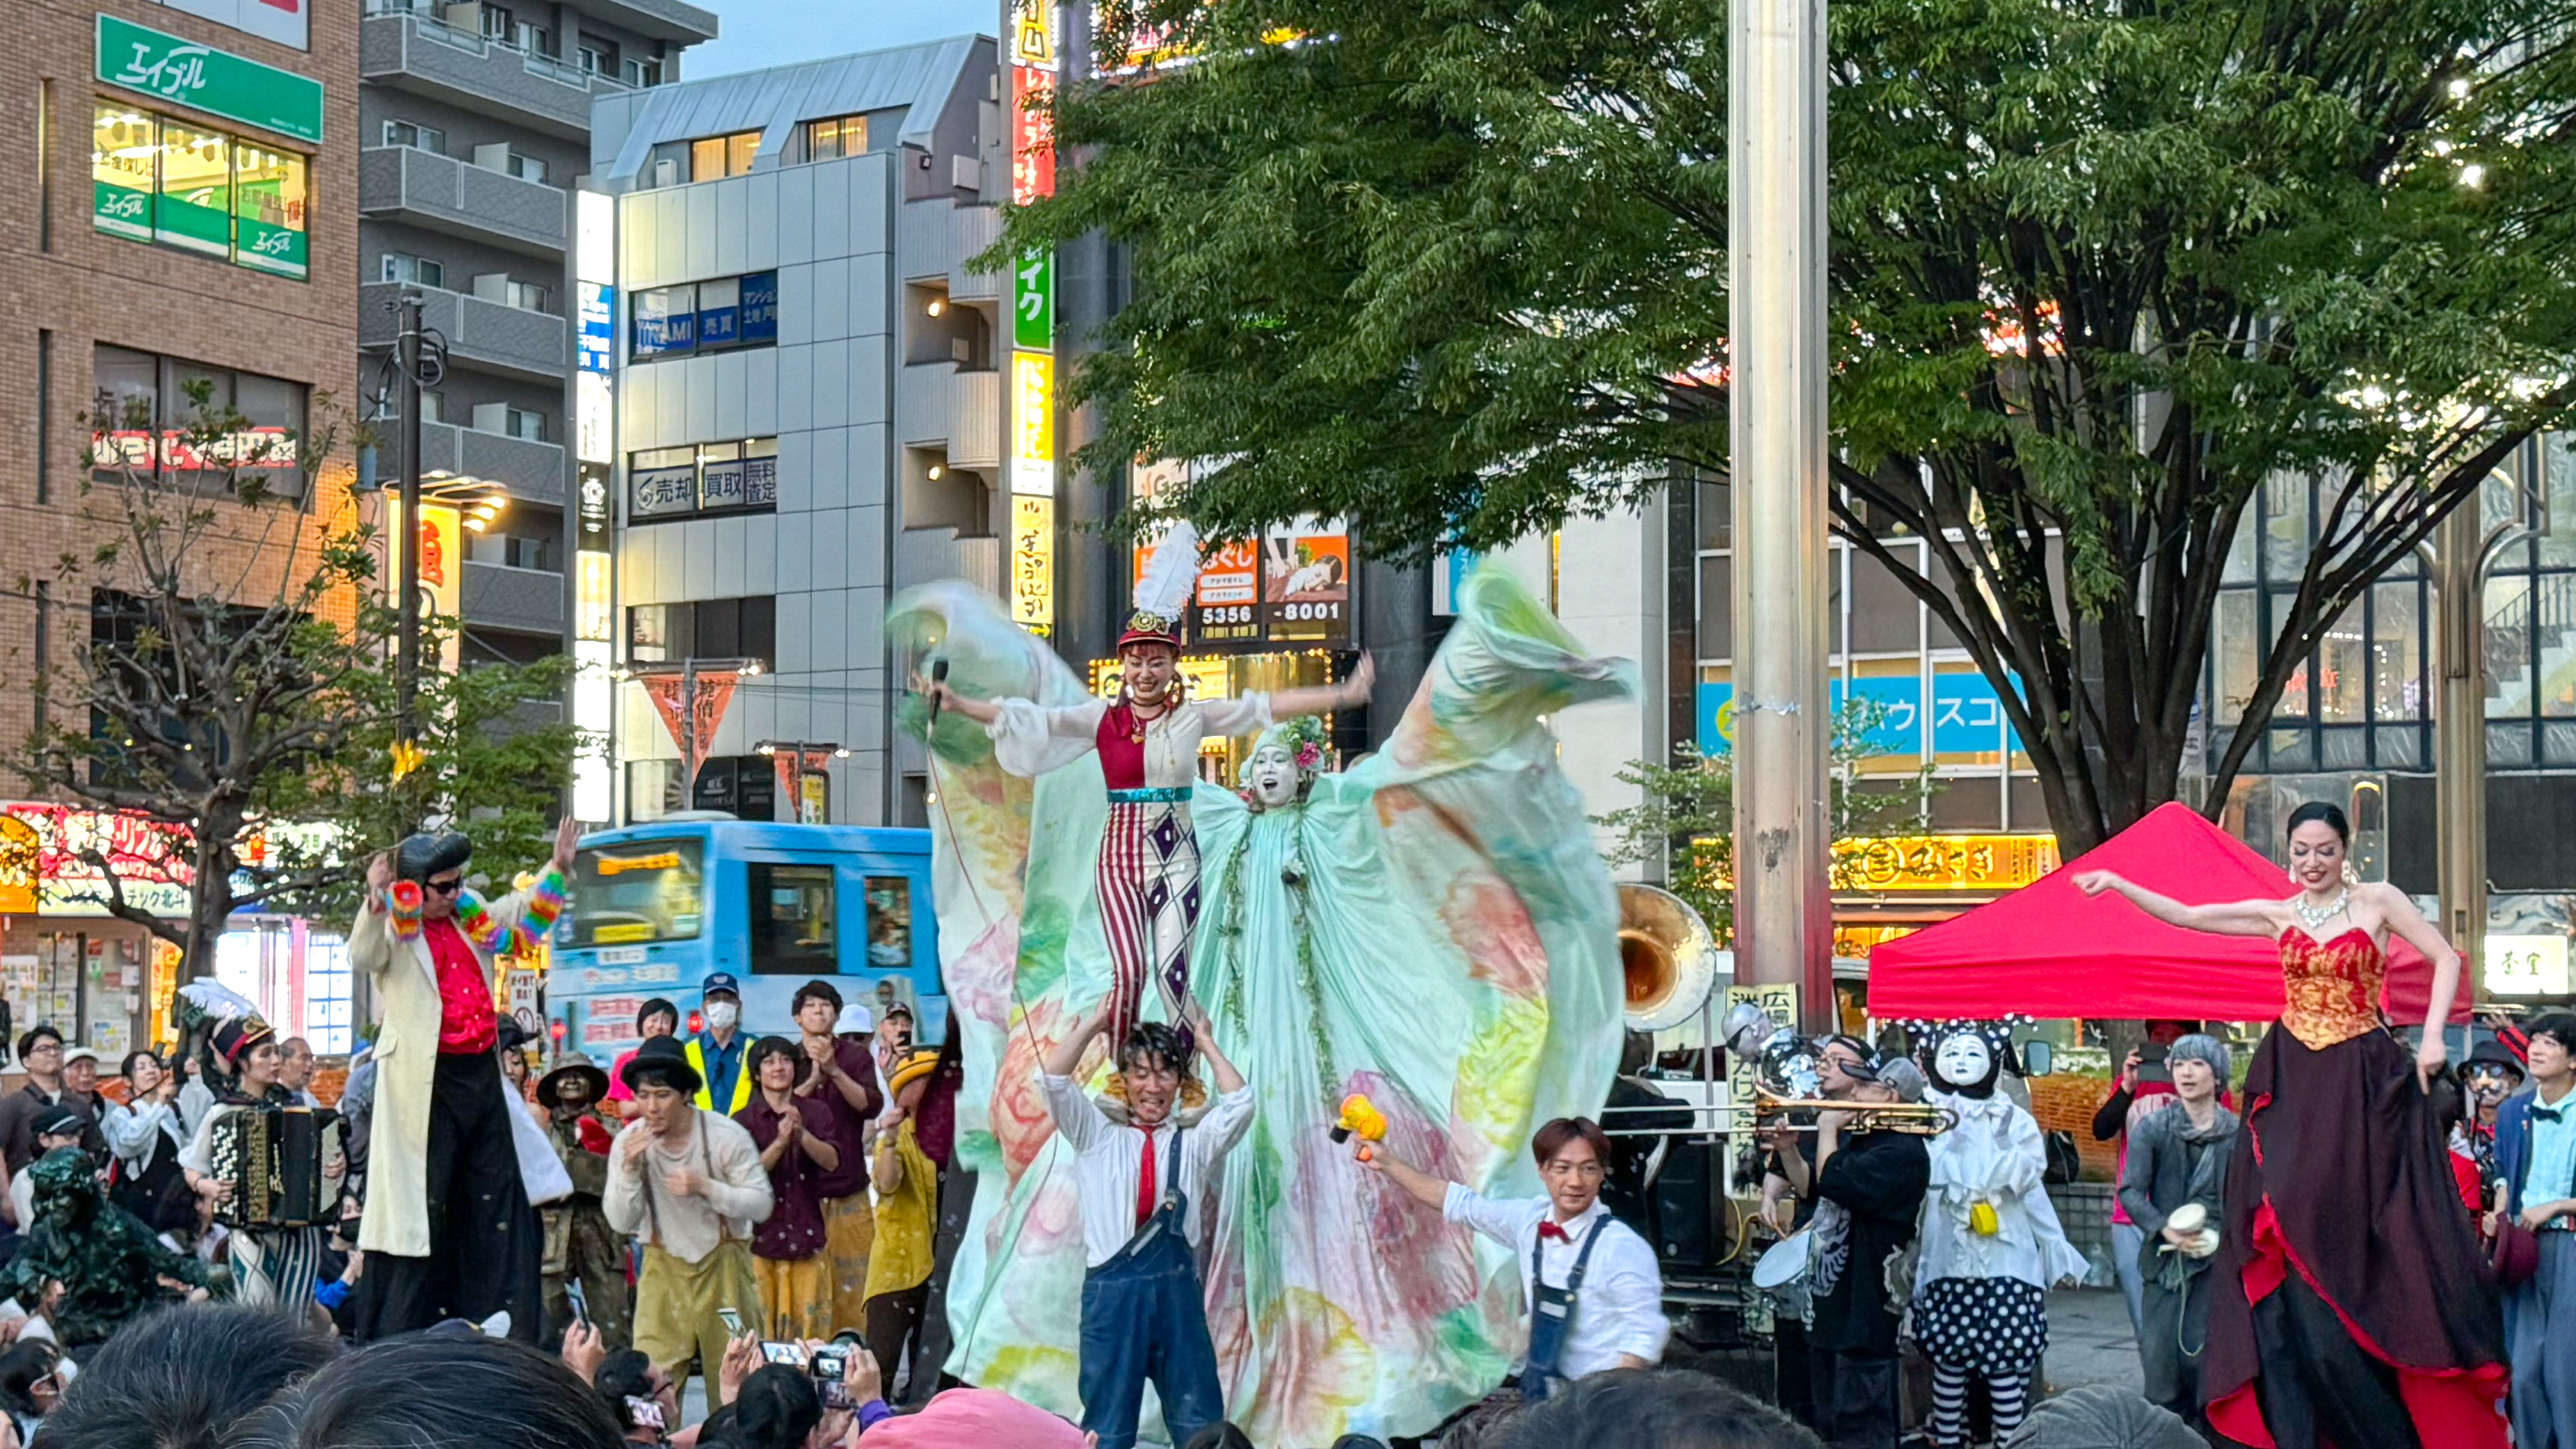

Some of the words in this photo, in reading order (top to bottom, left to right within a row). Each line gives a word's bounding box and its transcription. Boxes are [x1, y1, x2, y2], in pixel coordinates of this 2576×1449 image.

[115, 42, 209, 95] エイブル
[99, 193, 145, 218] エイブル
[251, 231, 293, 255] エイブル
[749, 461, 776, 483] 無料
[655, 477, 693, 504] 売却
[706, 472, 742, 499] 買取
[748, 483, 776, 503] 査定
[1202, 605, 1251, 625] 5356
[1273, 602, 1339, 621] -8001
